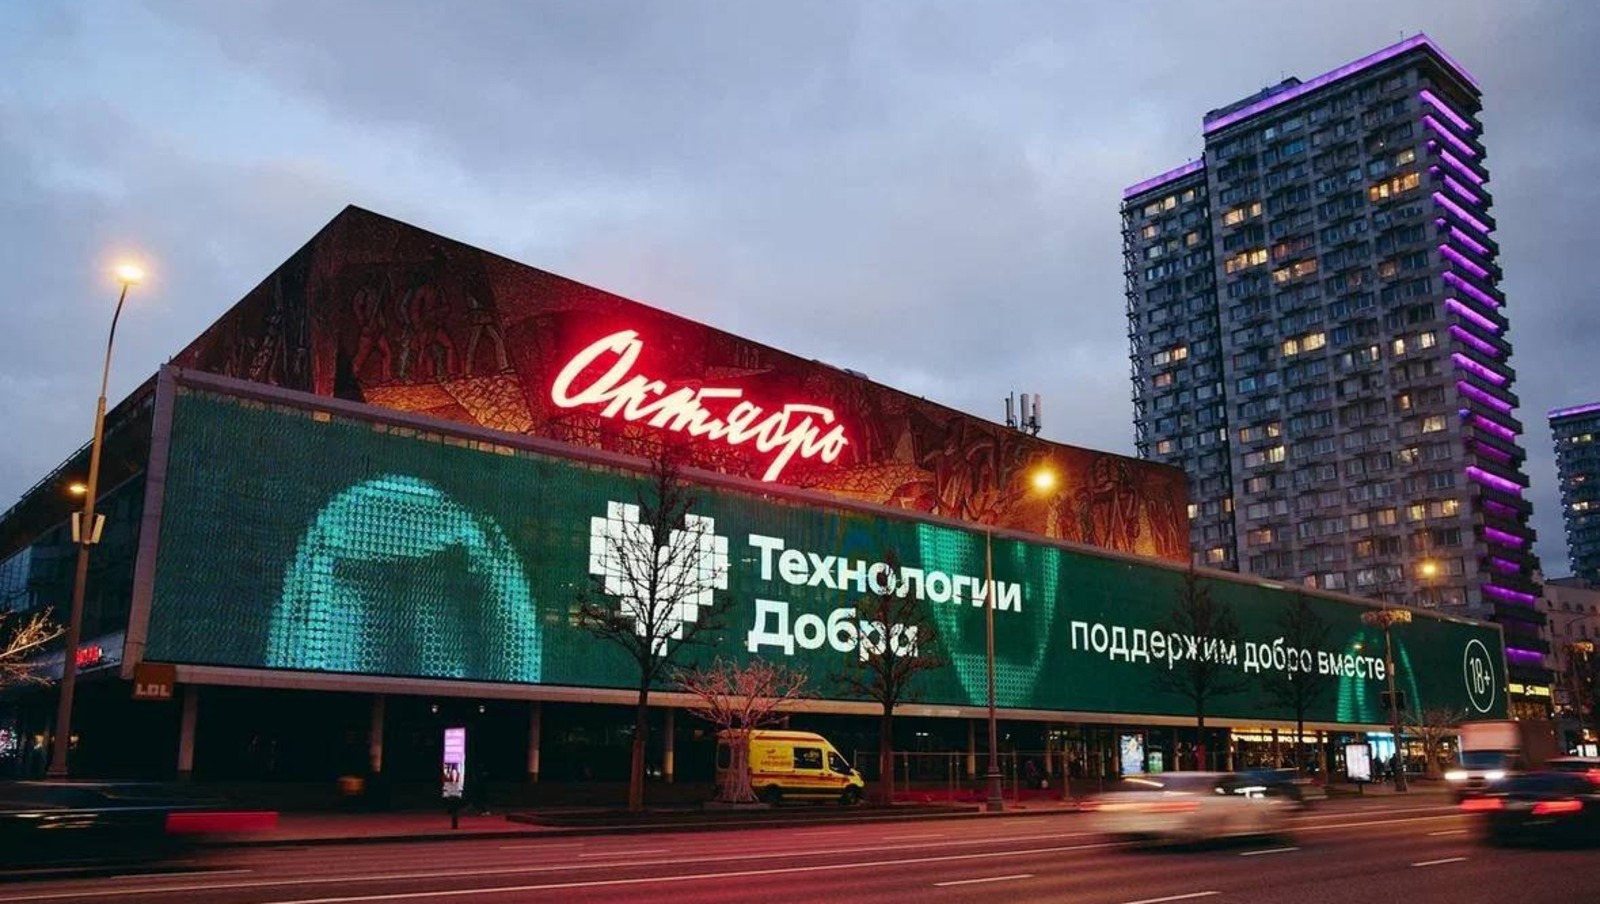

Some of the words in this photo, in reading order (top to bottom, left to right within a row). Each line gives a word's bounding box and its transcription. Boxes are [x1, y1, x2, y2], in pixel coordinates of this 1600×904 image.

[551, 329, 849, 482] Октябрь
[749, 533, 1022, 612] Технологии
[748, 599, 918, 662] Добра
[1071, 621, 1238, 669] поддержим
[1244, 637, 1312, 680] добро
[1318, 651, 1386, 680] вместе
[1469, 657, 1491, 695] 18+
